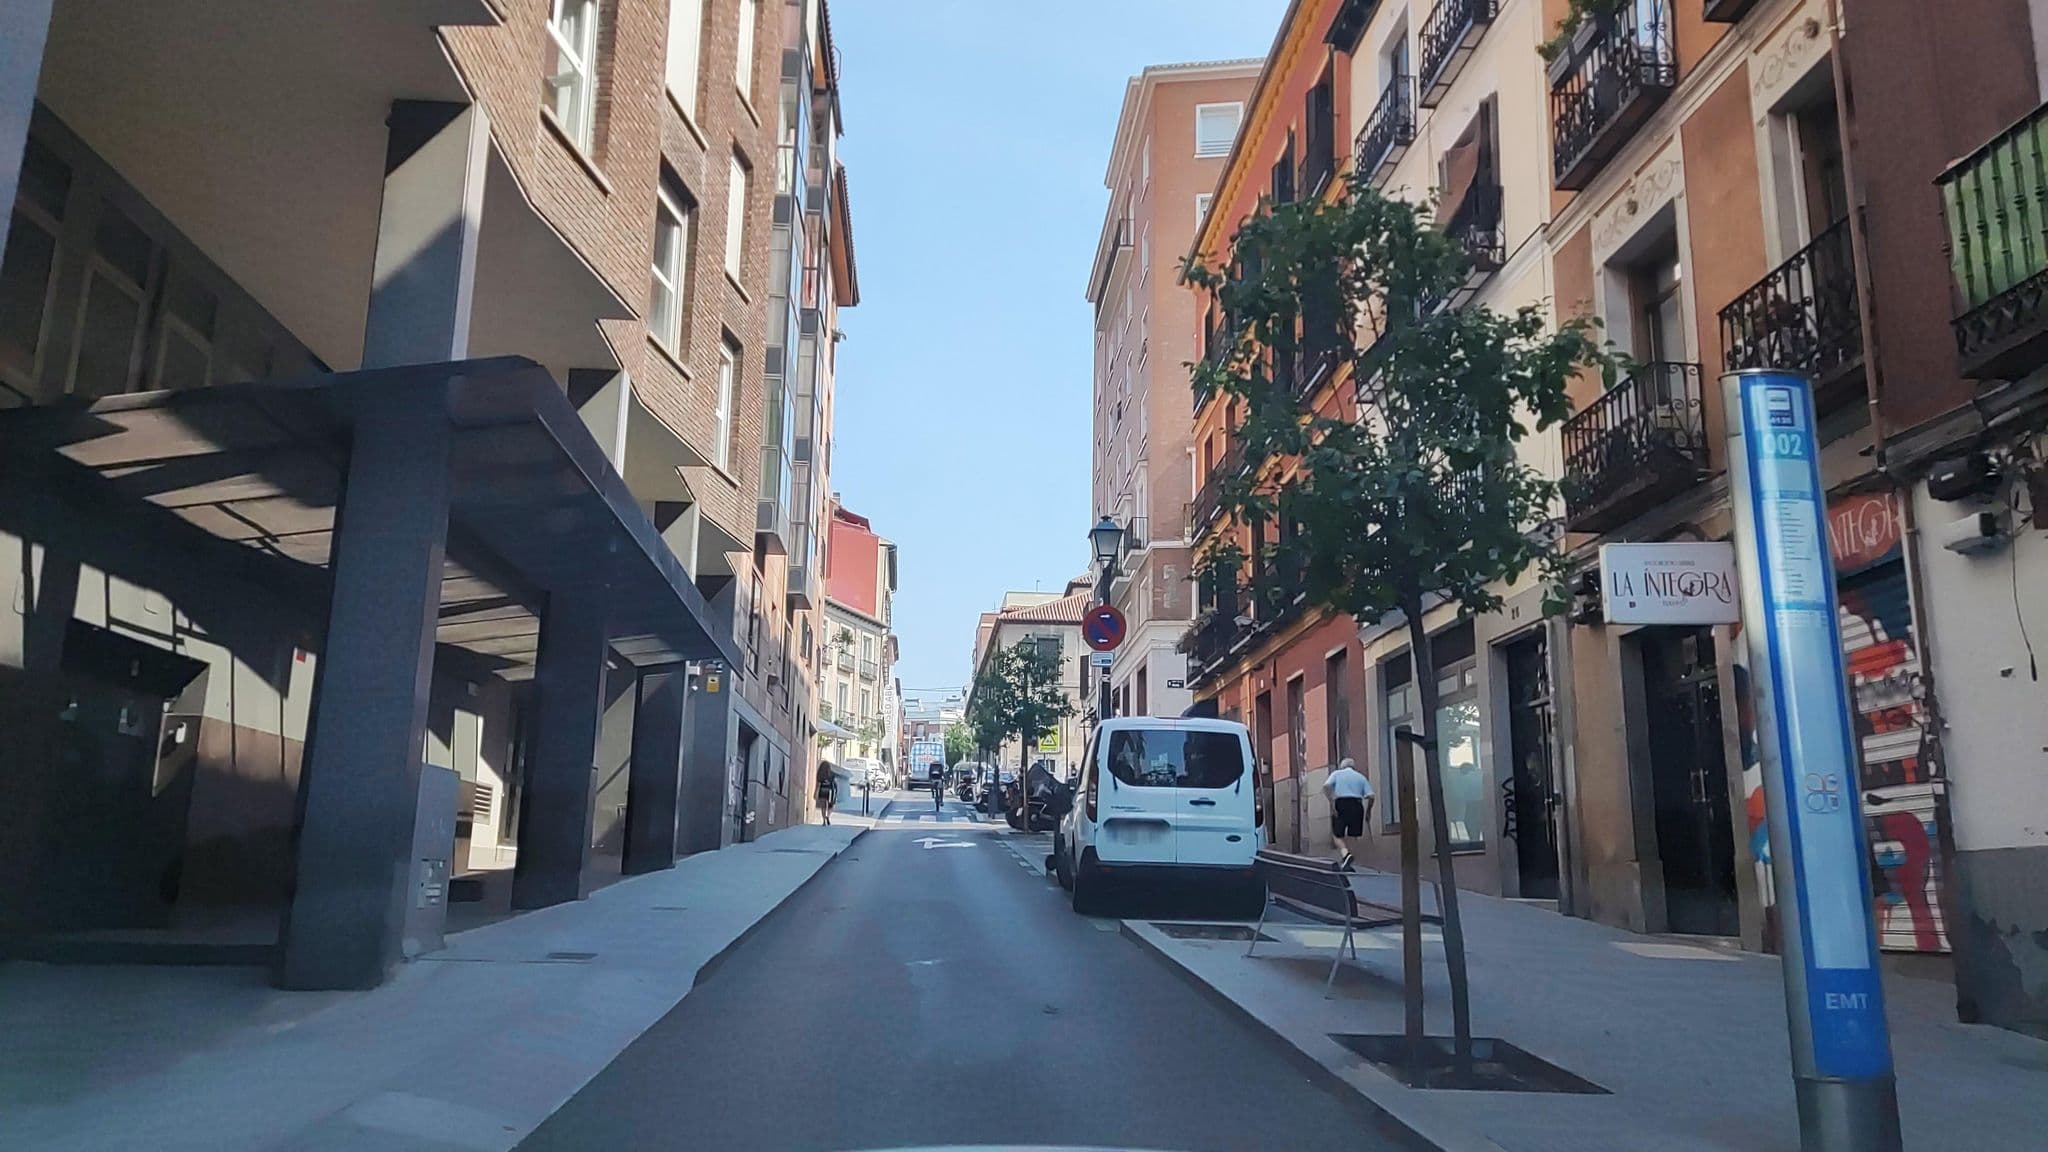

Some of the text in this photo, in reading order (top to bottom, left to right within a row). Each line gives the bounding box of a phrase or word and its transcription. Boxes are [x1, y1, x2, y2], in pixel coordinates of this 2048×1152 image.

[1762, 433, 1802, 455] 002
[1828, 493, 1900, 561] NTEGR
[1613, 567, 1732, 604] LA ÍNTEGRA
[1825, 993, 1869, 1010] EMT
